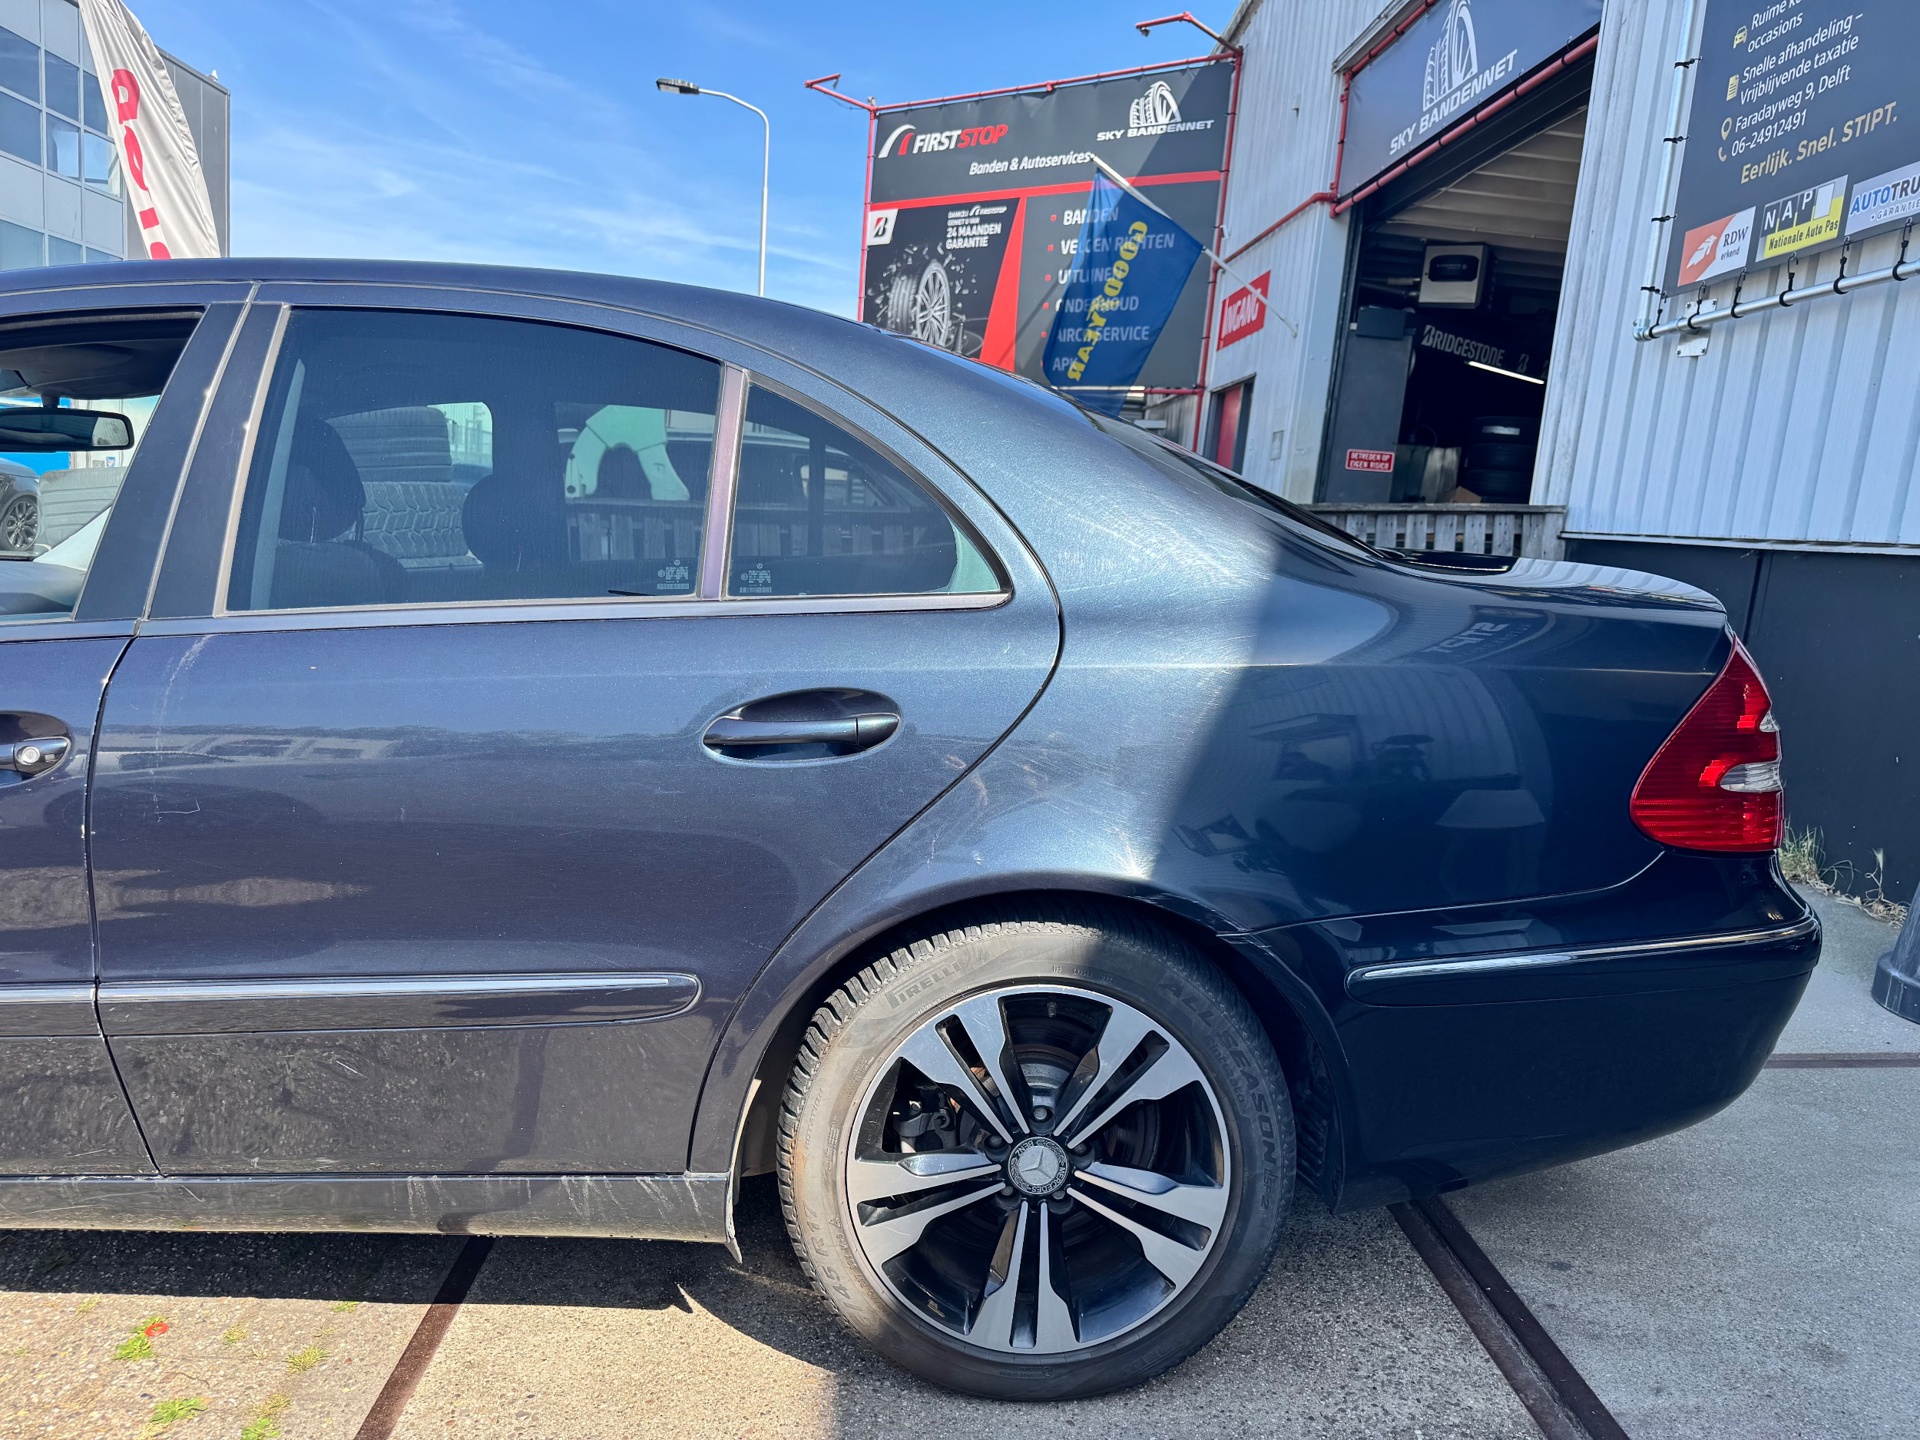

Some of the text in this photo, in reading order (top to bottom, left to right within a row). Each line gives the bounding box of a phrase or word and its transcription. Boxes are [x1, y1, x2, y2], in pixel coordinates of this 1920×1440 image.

[1747, 12, 1803, 53] occasions
[1751, 0, 1787, 30] Ruime
[1742, 55, 1776, 84] Snelle
[1778, 14, 1854, 65] afhandeling
[1740, 34, 1859, 105] Vrijblijvende taxatie
[1389, 49, 1518, 155] SKY BANDENNET
[1735, 64, 1852, 133] Faradayweg 9, Delft
[1096, 119, 1215, 141] SKY BANDENNET
[1731, 109, 1808, 157] 06-24912491
[1741, 101, 1898, 184] Eerlijk. Snel. STIPT.
[969, 151, 1092, 175] Banden & Autoservices
[945, 235, 989, 250] GARANTIE
[946, 222, 1002, 238] 24 MAANDEN
[1722, 225, 1749, 248] RDW
[1768, 218, 1839, 251] Nationale Auto Pas
[1720, 247, 1740, 261] erkend
[1421, 324, 1505, 367] BRIDGESTONE
[884, 957, 962, 1009] PIRELLI
[1159, 979, 1214, 1028] ALL
[1217, 1029, 1276, 1165] SEASON
[1015, 1140, 1034, 1156] BENZ
[1031, 1166, 1066, 1193] MERCEDES
